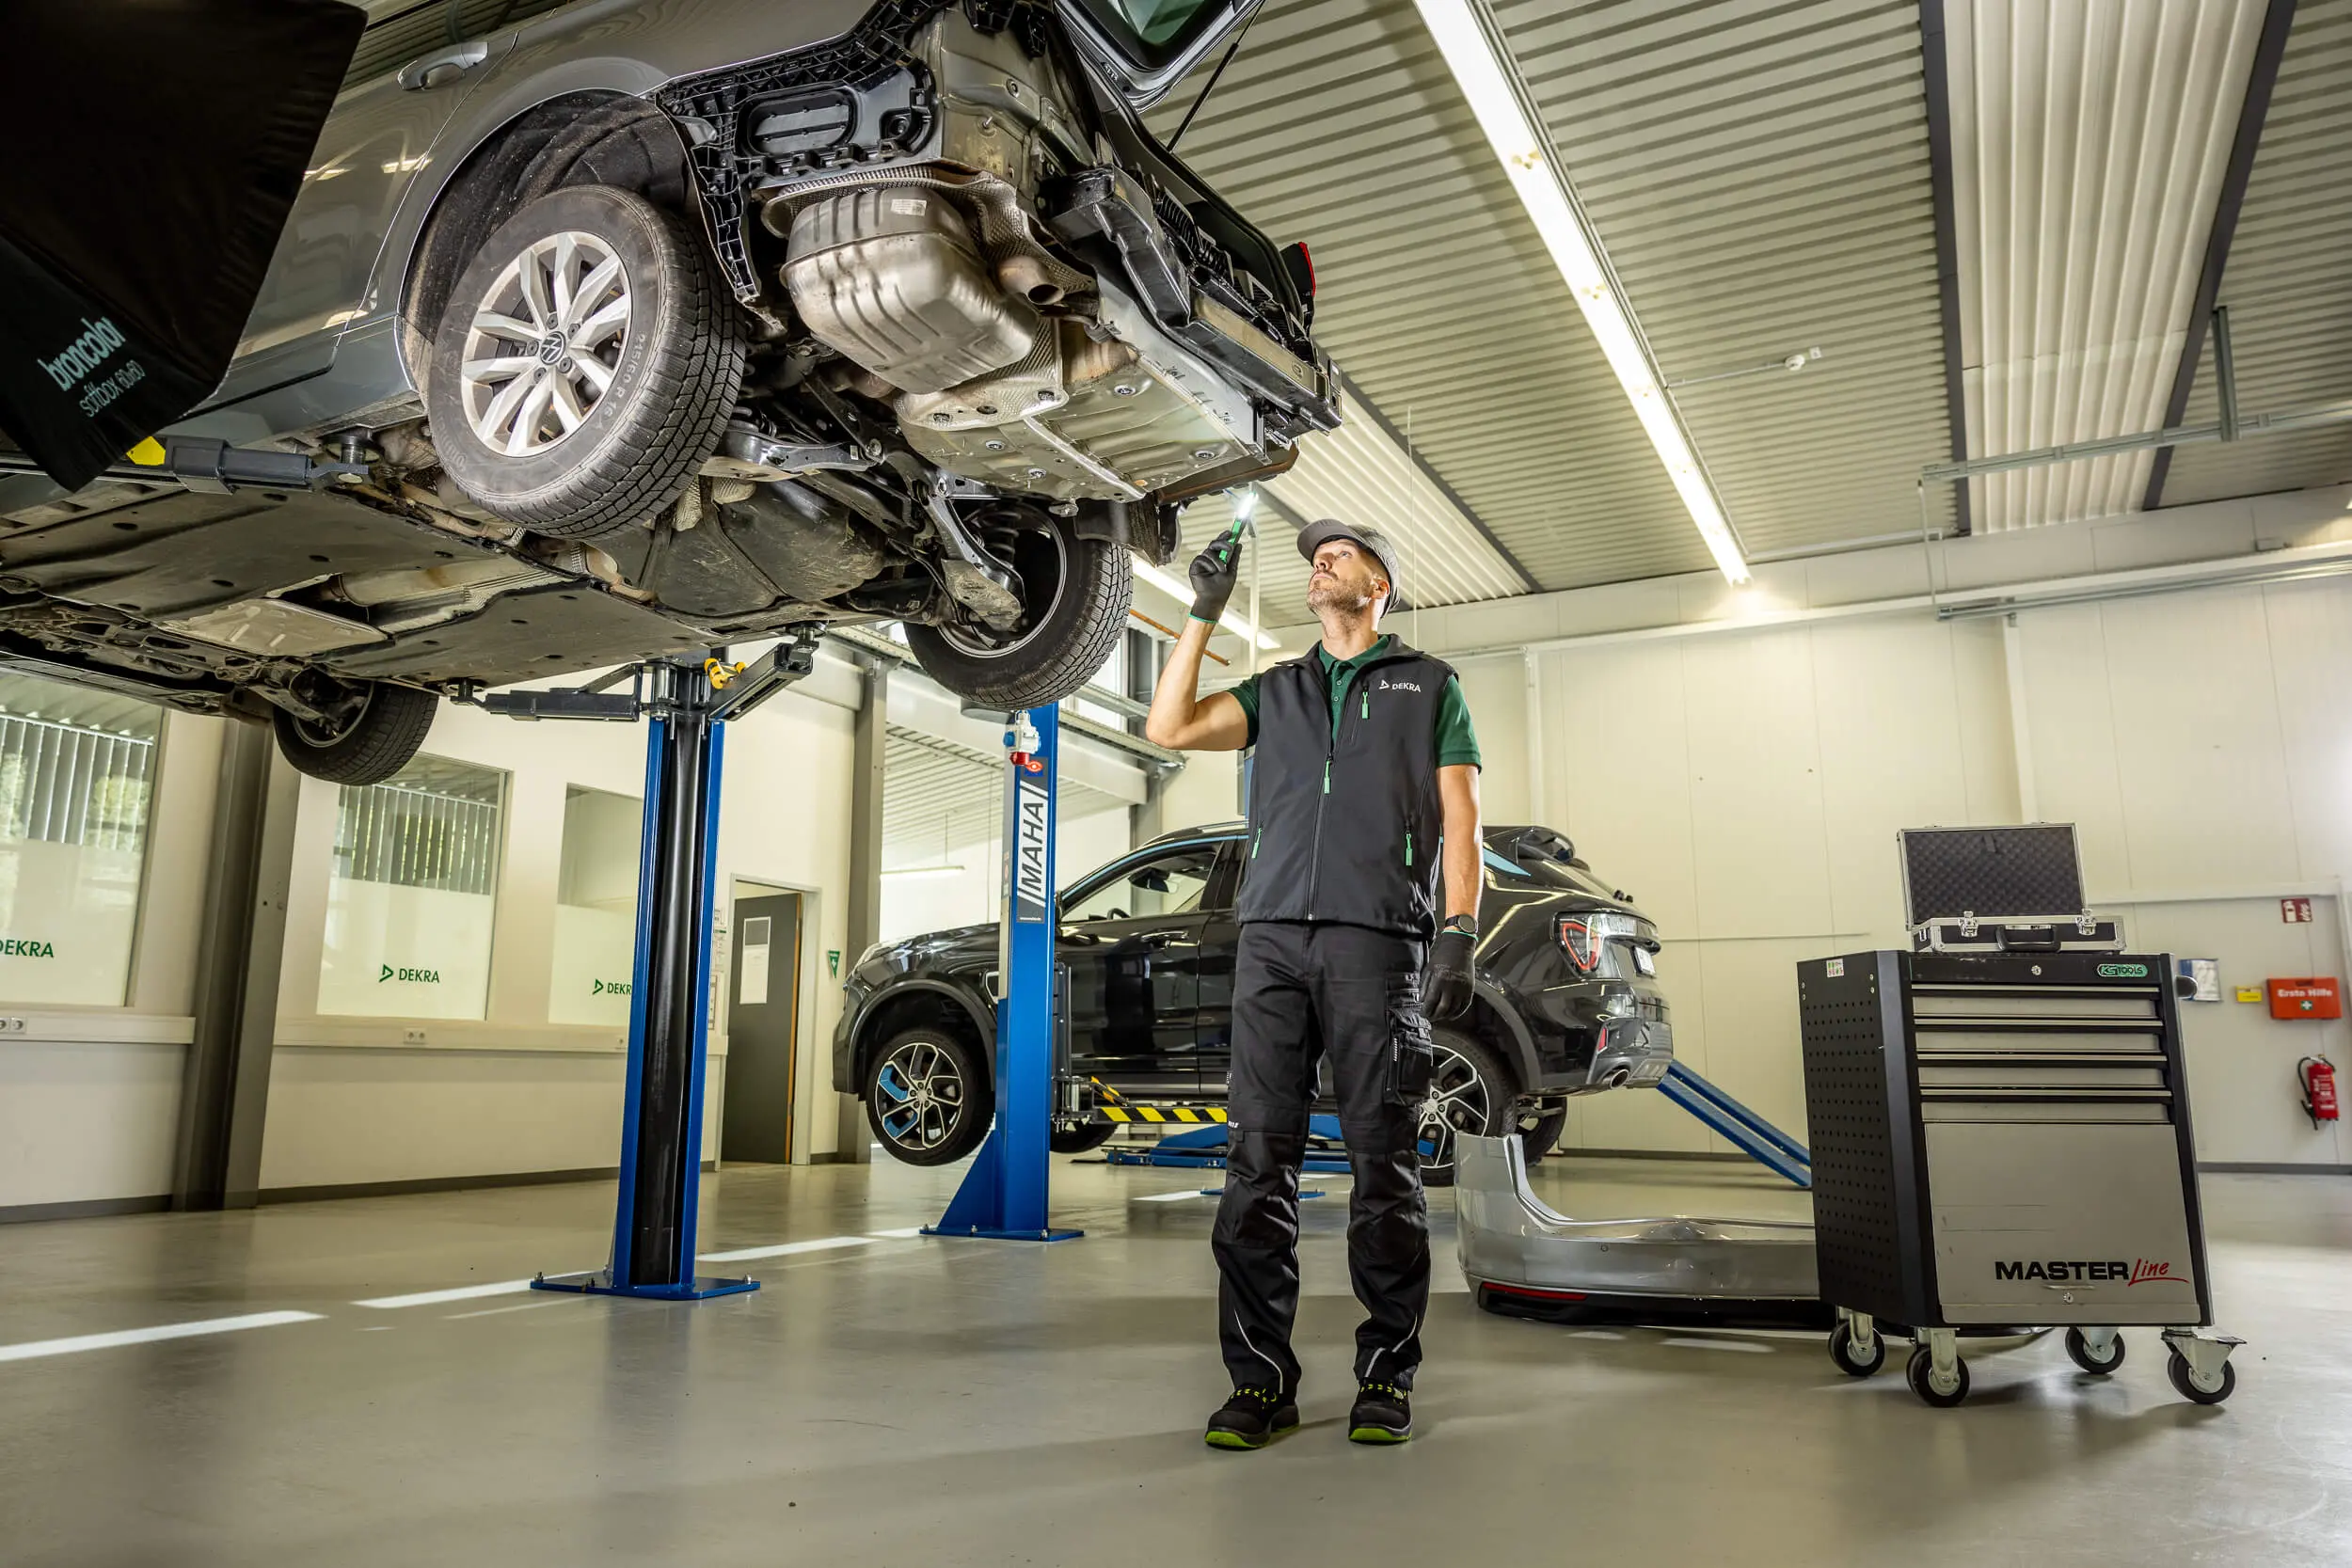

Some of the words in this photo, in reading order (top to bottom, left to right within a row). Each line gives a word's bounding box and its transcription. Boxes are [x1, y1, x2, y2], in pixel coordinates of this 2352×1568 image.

[37, 316, 126, 391] broncolor
[79, 376, 124, 417] softbox
[1391, 682, 1422, 693] DEKRA
[1021, 802, 1044, 892] MAHA
[0, 939, 54, 958] EKRA
[399, 968, 440, 983] DEKRA
[607, 982, 633, 995] DEKR
[1994, 1260, 2129, 1281] MASTER
[2128, 1258, 2189, 1287] Line
